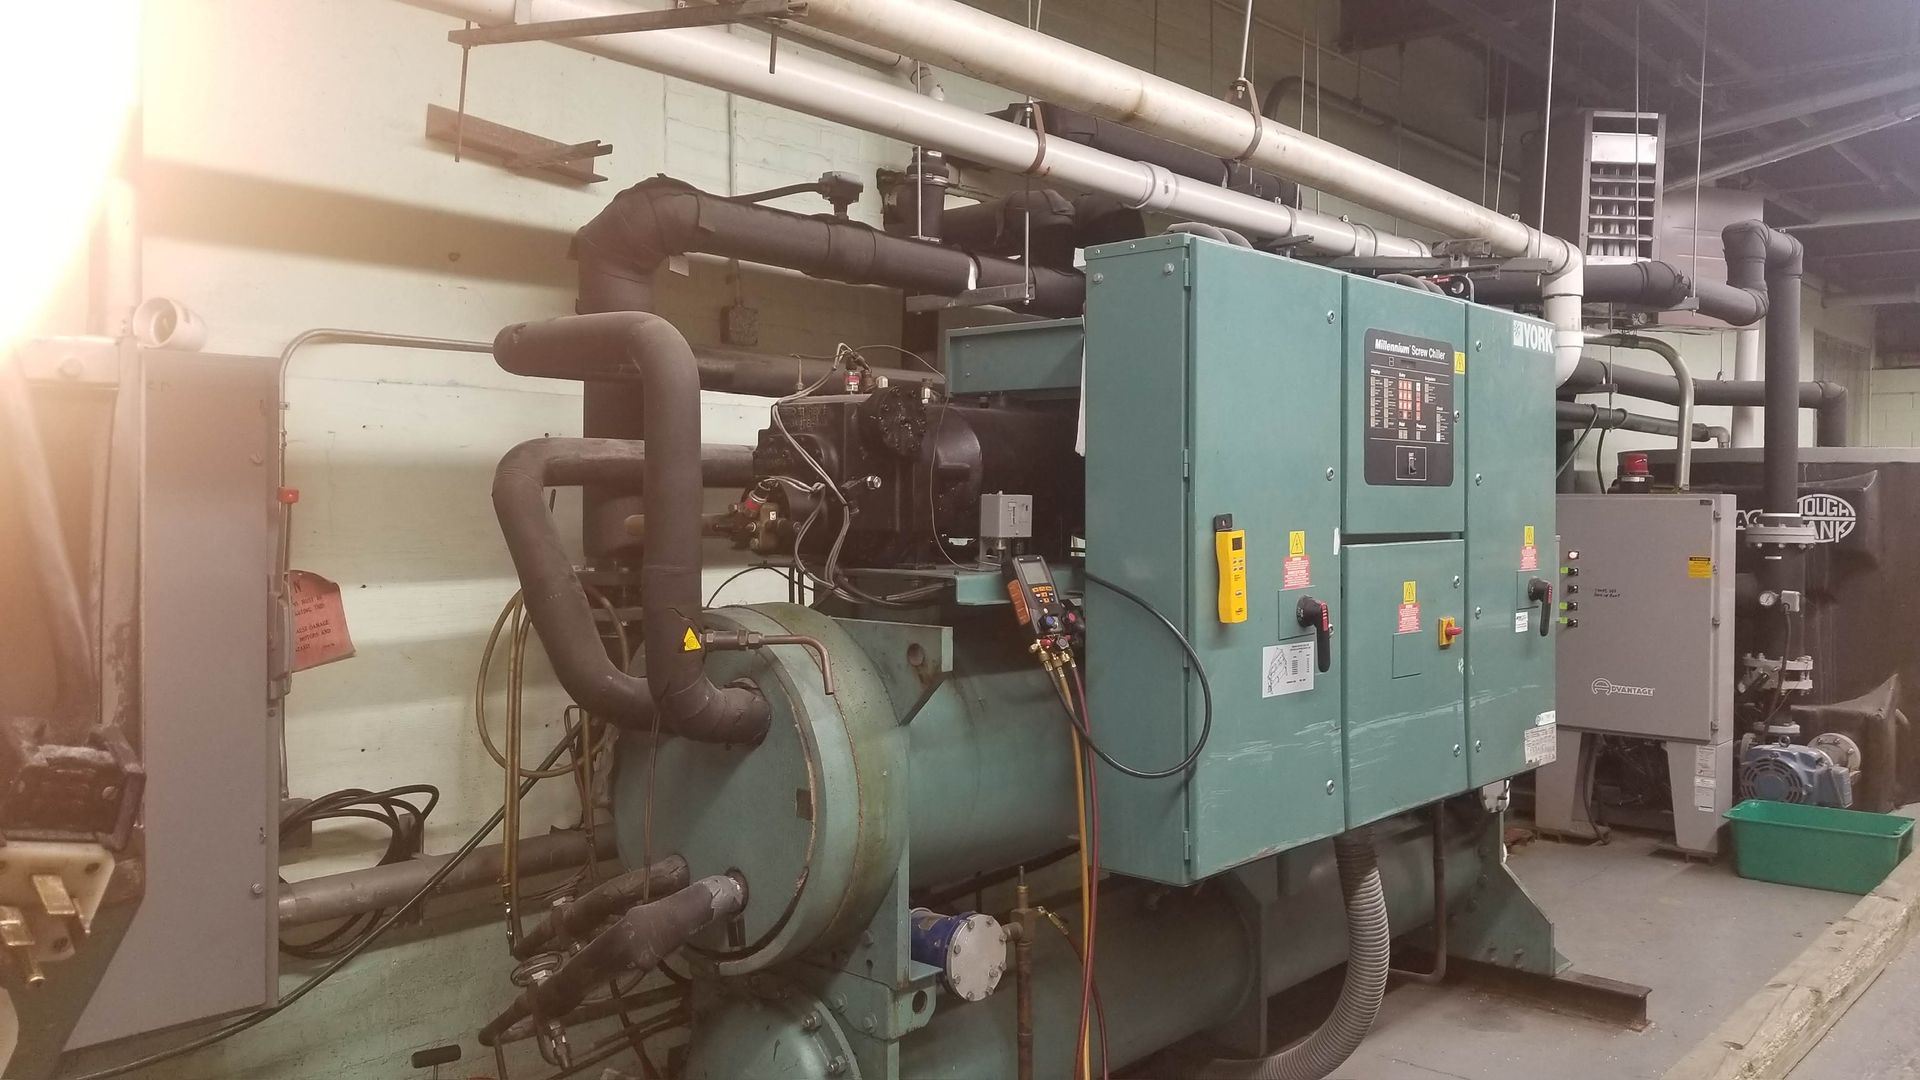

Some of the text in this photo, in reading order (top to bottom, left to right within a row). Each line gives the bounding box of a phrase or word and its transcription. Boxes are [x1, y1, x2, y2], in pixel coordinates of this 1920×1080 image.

[1375, 338, 1446, 361] Millennium Screw Chiller
[1523, 322, 1554, 354] YORK
[1591, 677, 1656, 697] ADVANTAGE
